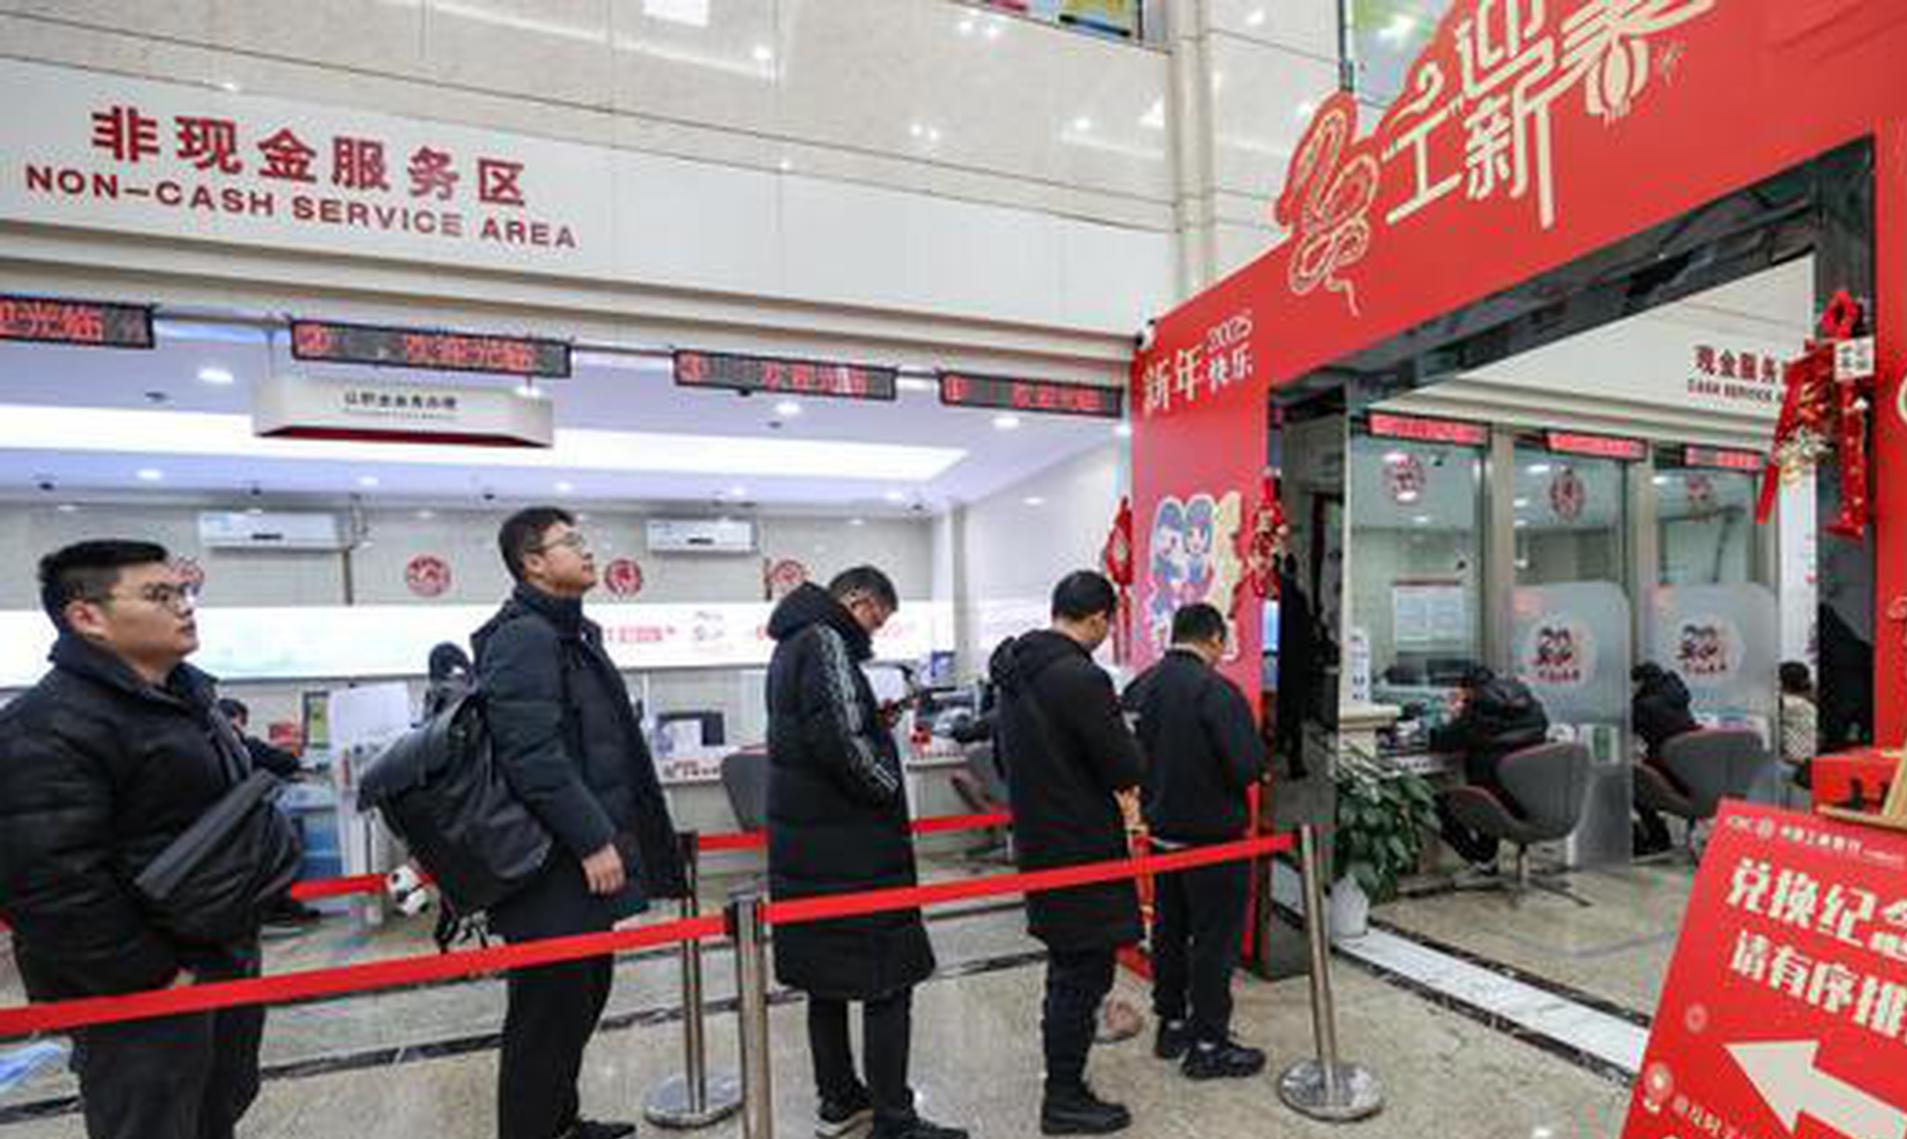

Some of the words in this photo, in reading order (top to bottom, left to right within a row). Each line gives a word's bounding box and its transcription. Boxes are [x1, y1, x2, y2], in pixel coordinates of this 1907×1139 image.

[91, 105, 525, 207] 非现金服务区
[292, 195, 462, 237] SERVICE
[480, 216, 577, 249] AREA
[1143, 343, 1205, 415] 新年
[1696, 345, 1787, 385] 现金服务
